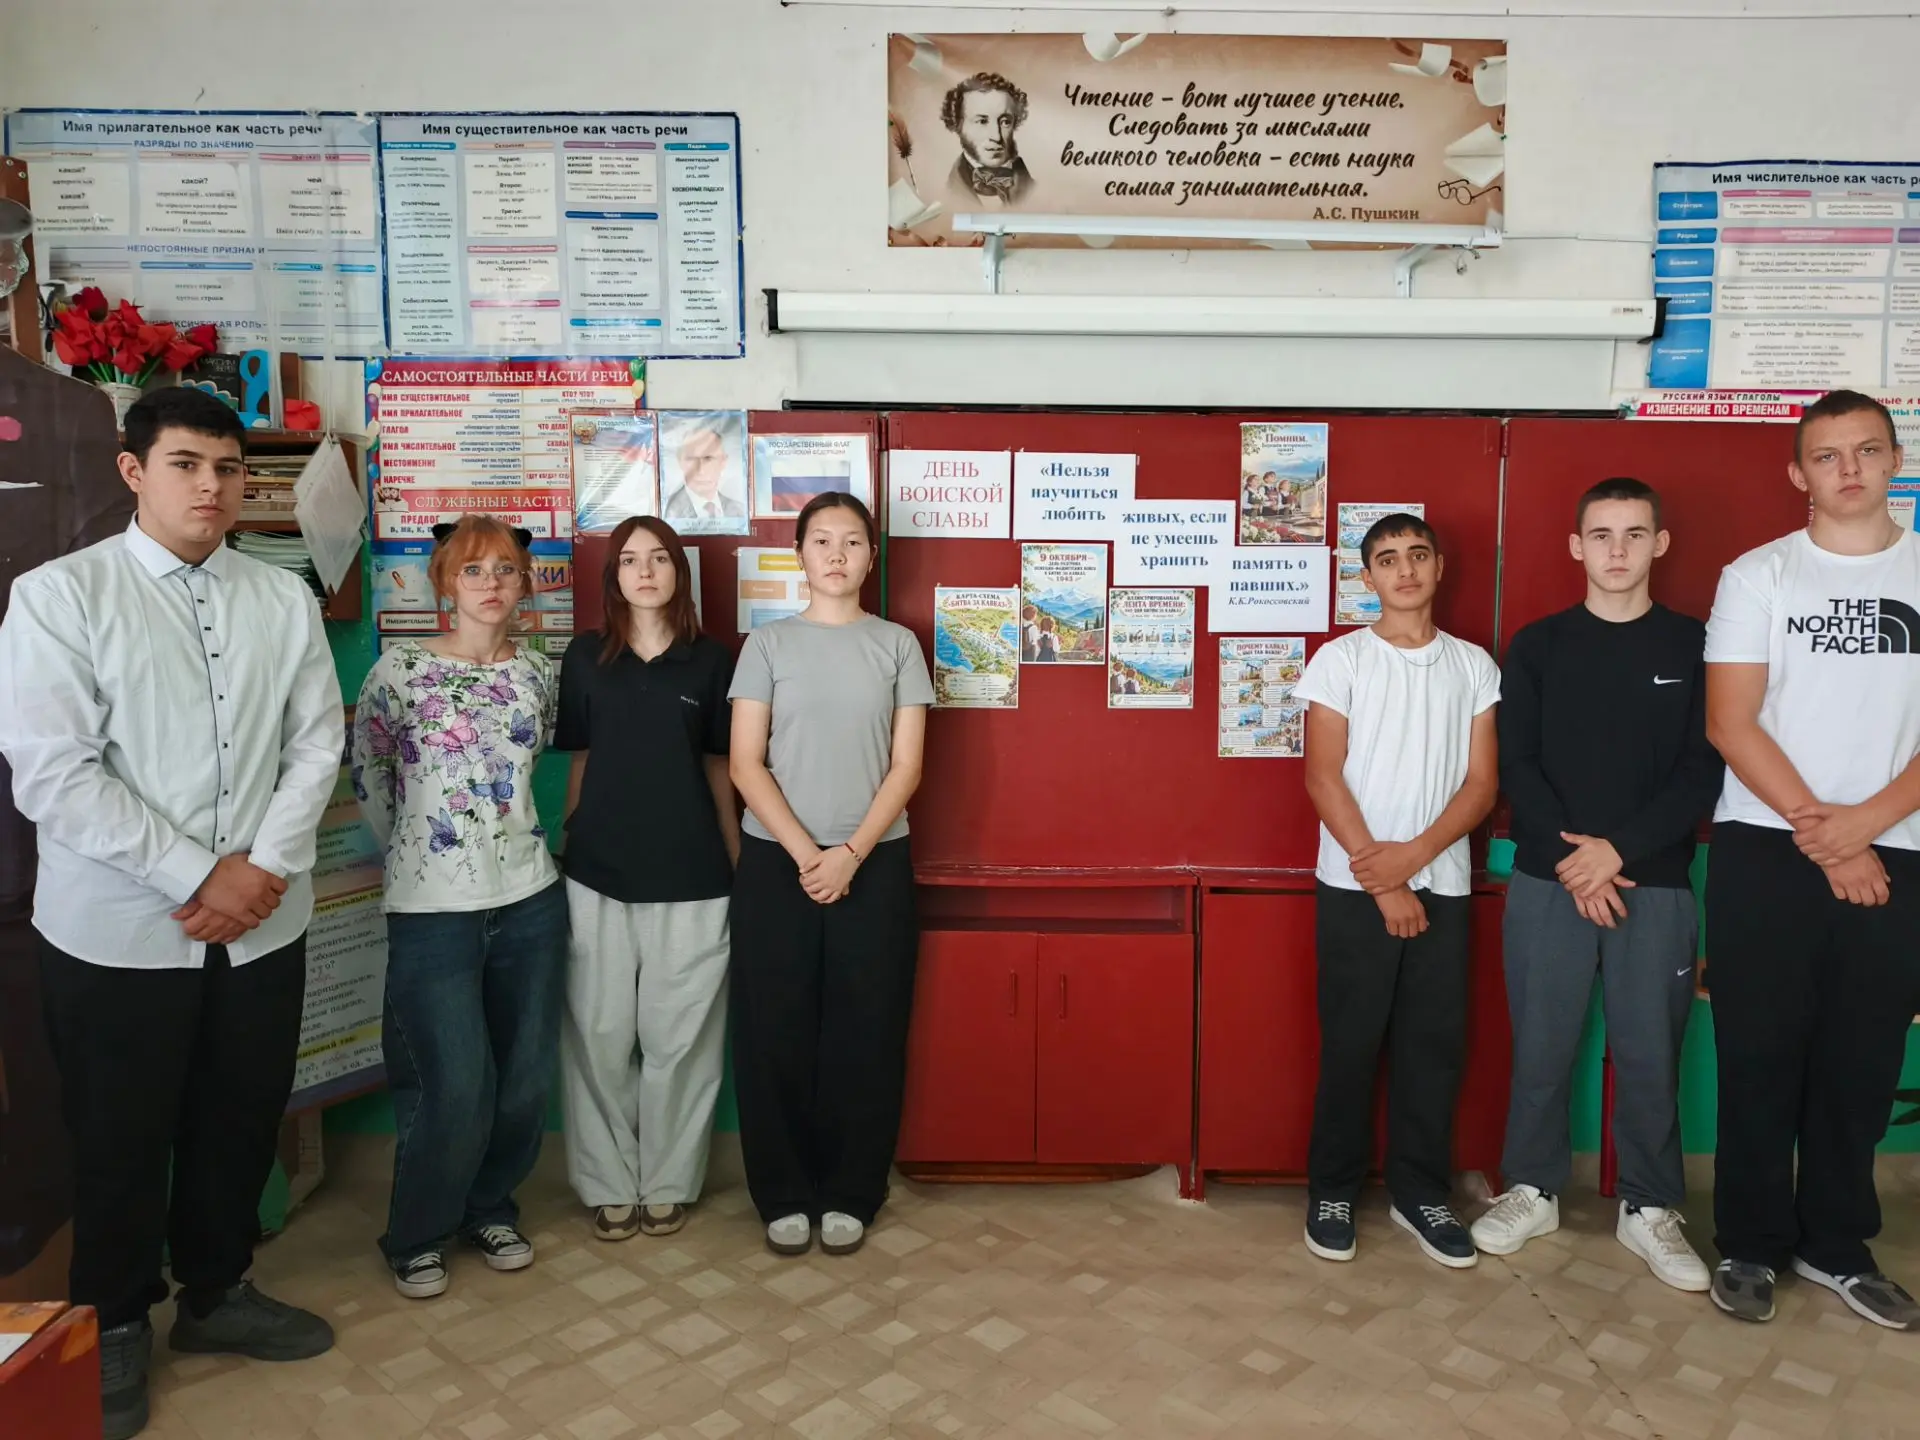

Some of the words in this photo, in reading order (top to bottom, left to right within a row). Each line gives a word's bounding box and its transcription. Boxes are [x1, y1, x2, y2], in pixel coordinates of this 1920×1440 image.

[1064, 82, 1154, 108] Чтение
[1181, 81, 1228, 108] вот
[1233, 92, 1316, 117] лучшее
[1318, 92, 1404, 116] учение.
[63, 120, 93, 132] Имя
[98, 123, 211, 135] прилагательное
[216, 124, 240, 133] как
[246, 125, 285, 135] часть
[422, 124, 451, 134] Имя
[455, 125, 579, 138] существительное
[583, 125, 607, 134] как
[611, 125, 650, 135] часть
[655, 126, 688, 138] речи
[1108, 112, 1228, 145] Следовать
[1229, 121, 1258, 145] за
[1265, 121, 1371, 137] мыслями
[134, 140, 180, 148] РАЗРЯДЫ
[201, 141, 254, 149] ЗНАЧЕНИЮ
[1060, 140, 1157, 167] великого
[1165, 140, 1262, 168] человека
[1289, 151, 1340, 167] есть
[1347, 152, 1416, 177] наука
[1712, 174, 1742, 184] Имя
[1746, 174, 1840, 183] числительное
[1843, 174, 1867, 183] как
[1871, 175, 1906, 184] часть
[1104, 180, 1175, 197] самая
[1174, 180, 1369, 206] занимательная.
[1313, 207, 1346, 220] А.С.
[1351, 207, 1420, 223] Пушкин
[127, 244, 208, 254] НЕПОСТОЯННЫЕ
[235, 321, 263, 329] РОЛЬ
[382, 370, 534, 383] САМОСТОЯТЕЛЬНЫЕ
[538, 370, 587, 382] ЧАСТИ
[592, 370, 629, 382] РЕЧИ
[382, 393, 398, 401] ИМЯ
[400, 393, 471, 402] СУЩЕСТВИТЕЛЬНОЕ
[1662, 392, 1704, 401] РУССКИЙ
[1707, 392, 1734, 401] ЯЗЫК.
[1736, 393, 1781, 401] ГЛАГОЛЫ
[382, 409, 398, 417] ИМЯ
[400, 409, 463, 417] ПРИЛАГАТЕЛЬНОЕ
[1646, 404, 1711, 416] ИЗМЕНЕНИЕ
[1714, 405, 1728, 415] ПО
[1732, 405, 1790, 416] ВРЕМЕНАМ
[382, 426, 409, 434] ГЛАГОЛ
[382, 442, 398, 450] ИМЯ
[401, 442, 456, 451] ЧИСЛИТЕЛЬНОЕ
[383, 459, 436, 467] МЕСТОИМЕНИЕ
[923, 461, 979, 479] ДЕНЬ
[1040, 463, 1110, 477] «Нельзя
[384, 475, 415, 483] НАРЕЧИЕ
[1031, 487, 1118, 502] научиться
[415, 496, 508, 508] СЛУЖЕБНЫЕ
[512, 496, 559, 508] ЧАСТИ
[400, 515, 440, 524] ПРЕДЛОГ
[912, 511, 989, 528] СЛАВЫ
[1042, 507, 1106, 521] любить
[1122, 511, 1185, 525] живых,
[1190, 512, 1227, 524] если
[1131, 534, 1150, 545] не
[1155, 534, 1218, 548] умеешь
[1140, 556, 1208, 570] хранить
[1232, 560, 1293, 570] память
[1298, 560, 1307, 570] о
[1230, 581, 1309, 592] павших.»
[1228, 597, 1311, 606] К.К.Рокоссовский
[1828, 598, 1877, 616] THE
[1787, 616, 1876, 635] NORTH
[1811, 635, 1875, 654] FACE
